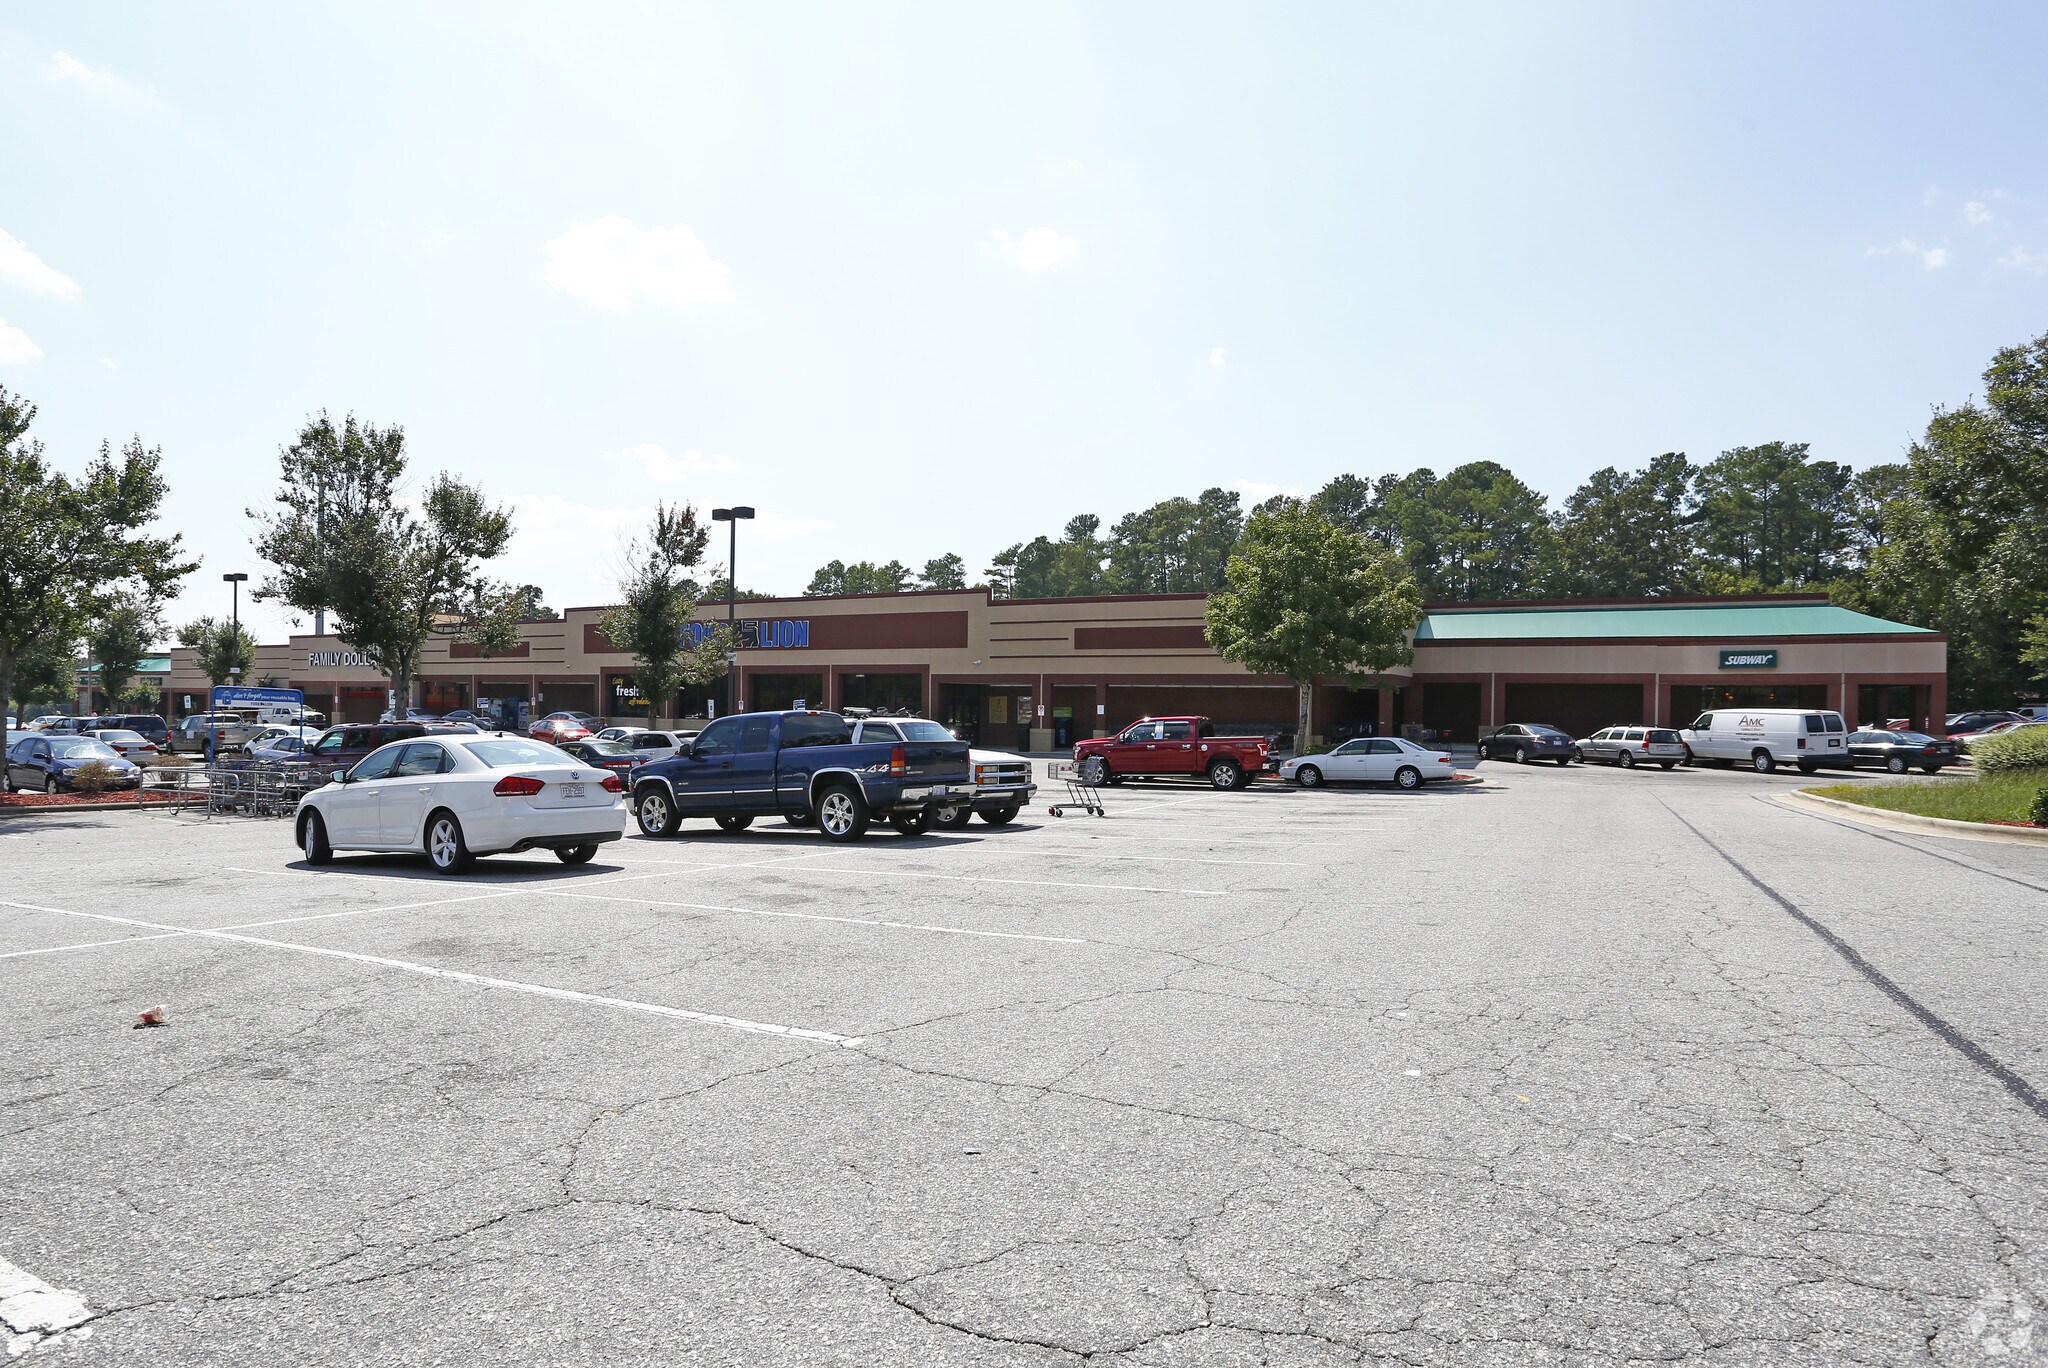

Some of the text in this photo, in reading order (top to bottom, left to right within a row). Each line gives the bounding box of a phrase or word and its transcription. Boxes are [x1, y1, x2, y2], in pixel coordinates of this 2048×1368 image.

[761, 620, 809, 648] LION
[308, 652, 378, 666] FAMILY DOLL
[1725, 655, 1773, 665] SUBWAY
